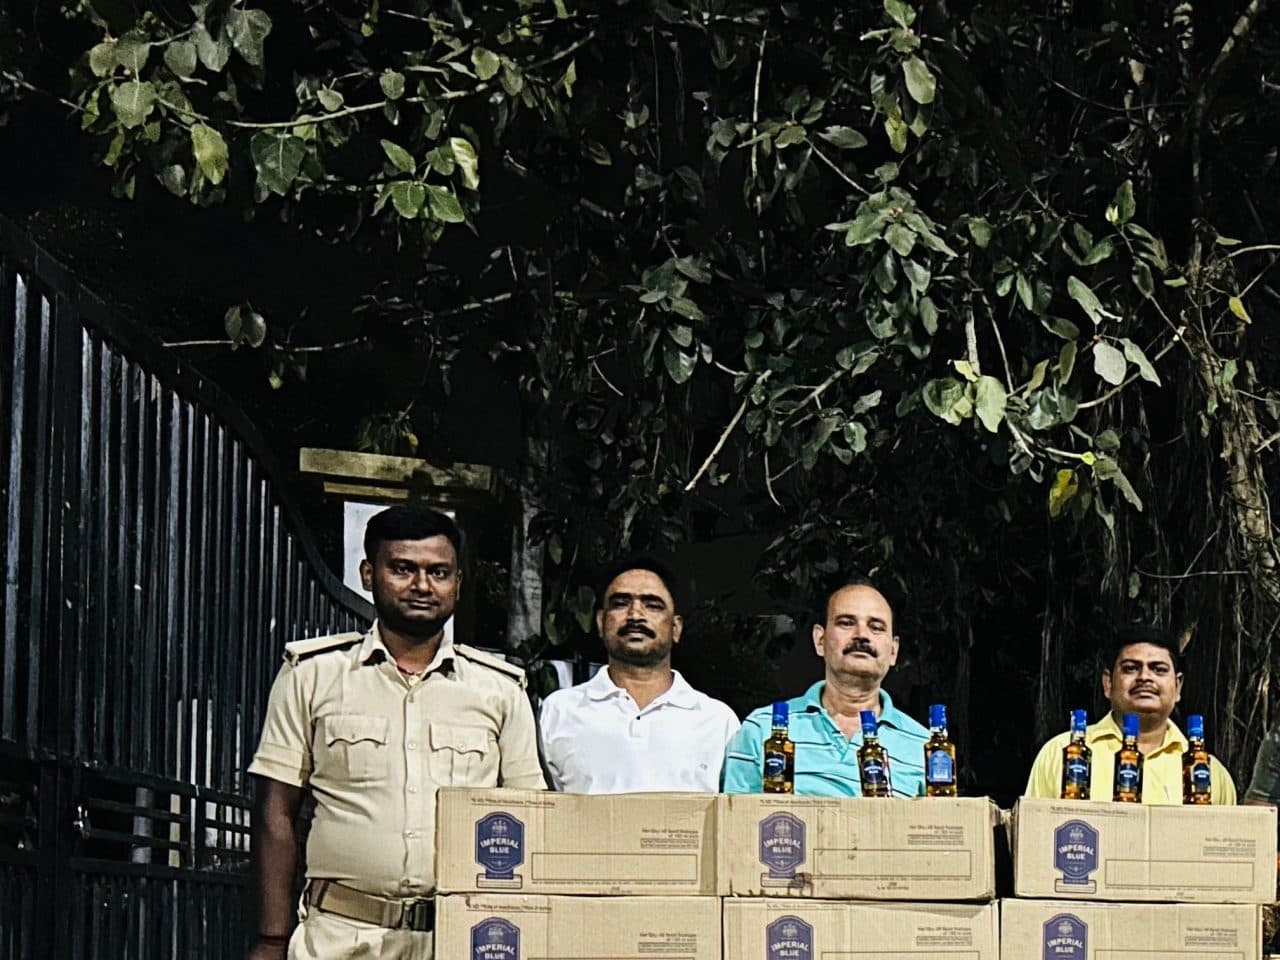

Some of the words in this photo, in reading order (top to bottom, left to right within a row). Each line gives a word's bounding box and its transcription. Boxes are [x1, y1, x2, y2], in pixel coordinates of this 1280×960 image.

[480, 838, 519, 849] IMPERIAL
[763, 837, 801, 849] IMPERIAL
[490, 846, 510, 854] BLUE
[1058, 844, 1094, 856] IMPERIAL
[770, 941, 809, 952] IMPERIAL
[1047, 937, 1083, 949] IMPERIAL
[475, 943, 515, 955] IMPERIAL
[484, 952, 505, 960] BLUE
